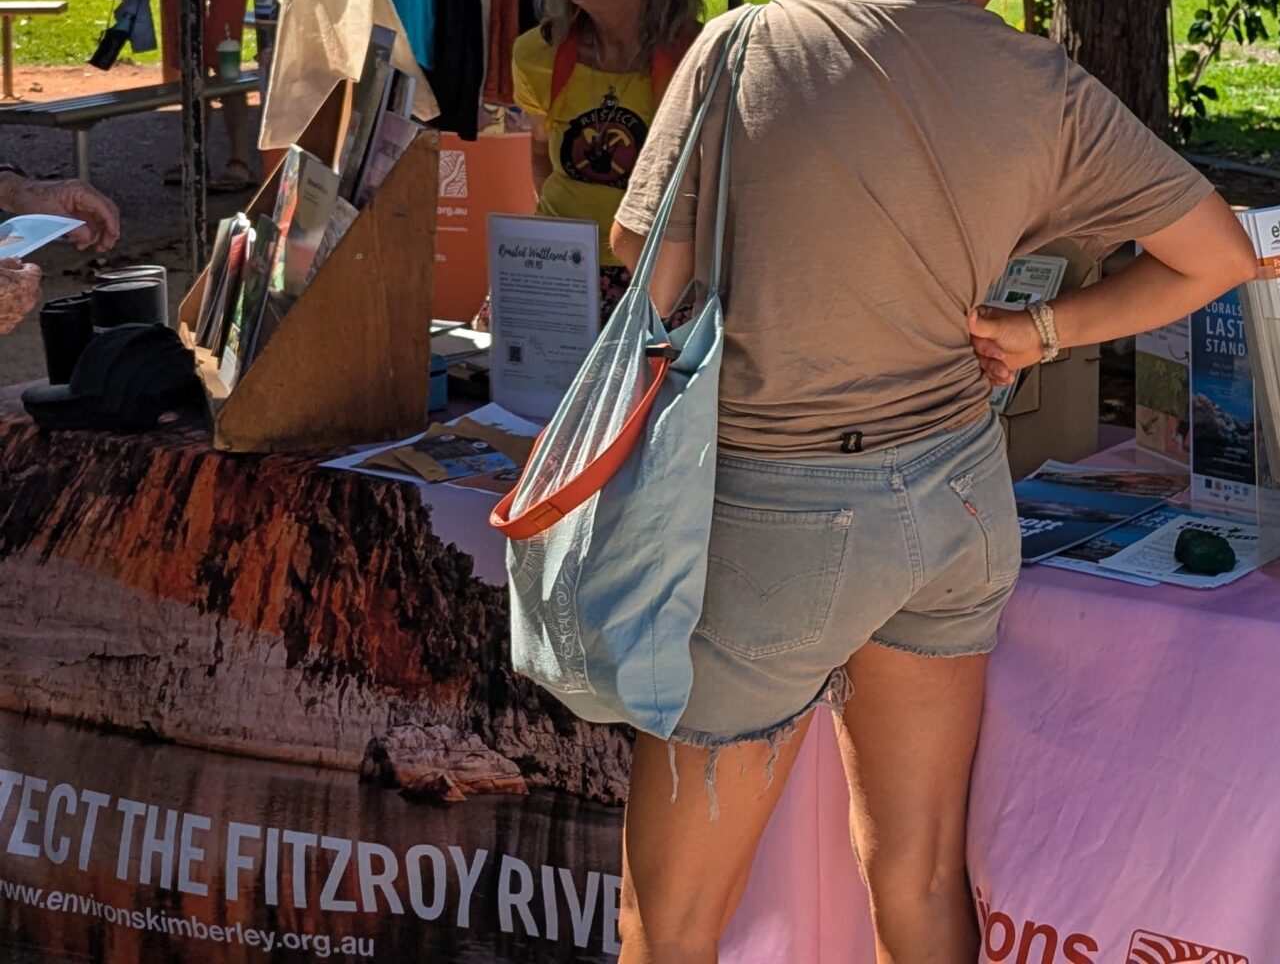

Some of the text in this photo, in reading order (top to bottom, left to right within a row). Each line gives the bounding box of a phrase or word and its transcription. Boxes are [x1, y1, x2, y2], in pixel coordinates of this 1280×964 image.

[1206, 316, 1245, 339] LAST
[1206, 338, 1246, 357] STAND
[0, 768, 624, 956] TECT THE FITZROY RIVE
